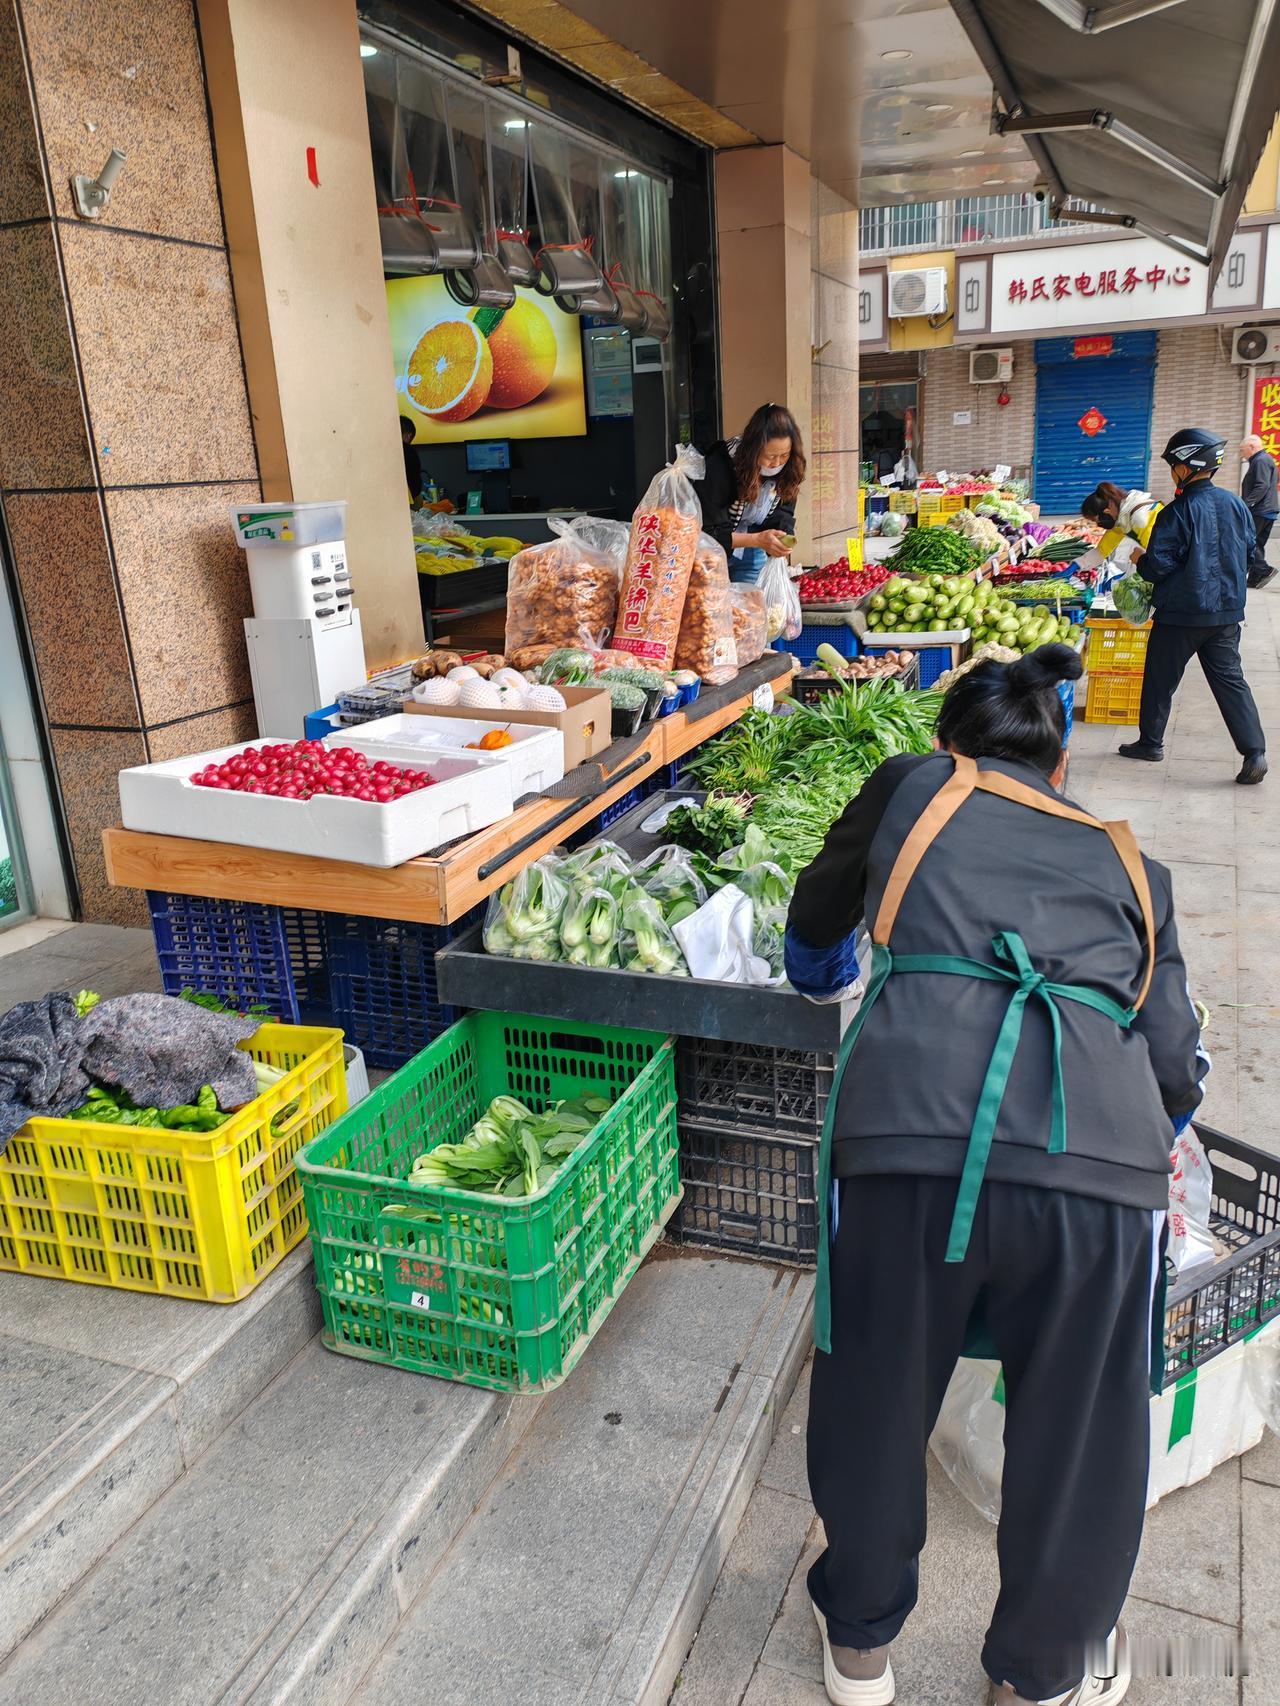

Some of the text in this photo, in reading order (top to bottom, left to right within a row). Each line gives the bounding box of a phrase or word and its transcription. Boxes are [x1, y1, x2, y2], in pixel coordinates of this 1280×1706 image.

[1008, 264, 1191, 304] 韩氏家电服务中心
[417, 1296, 424, 1306] 4
